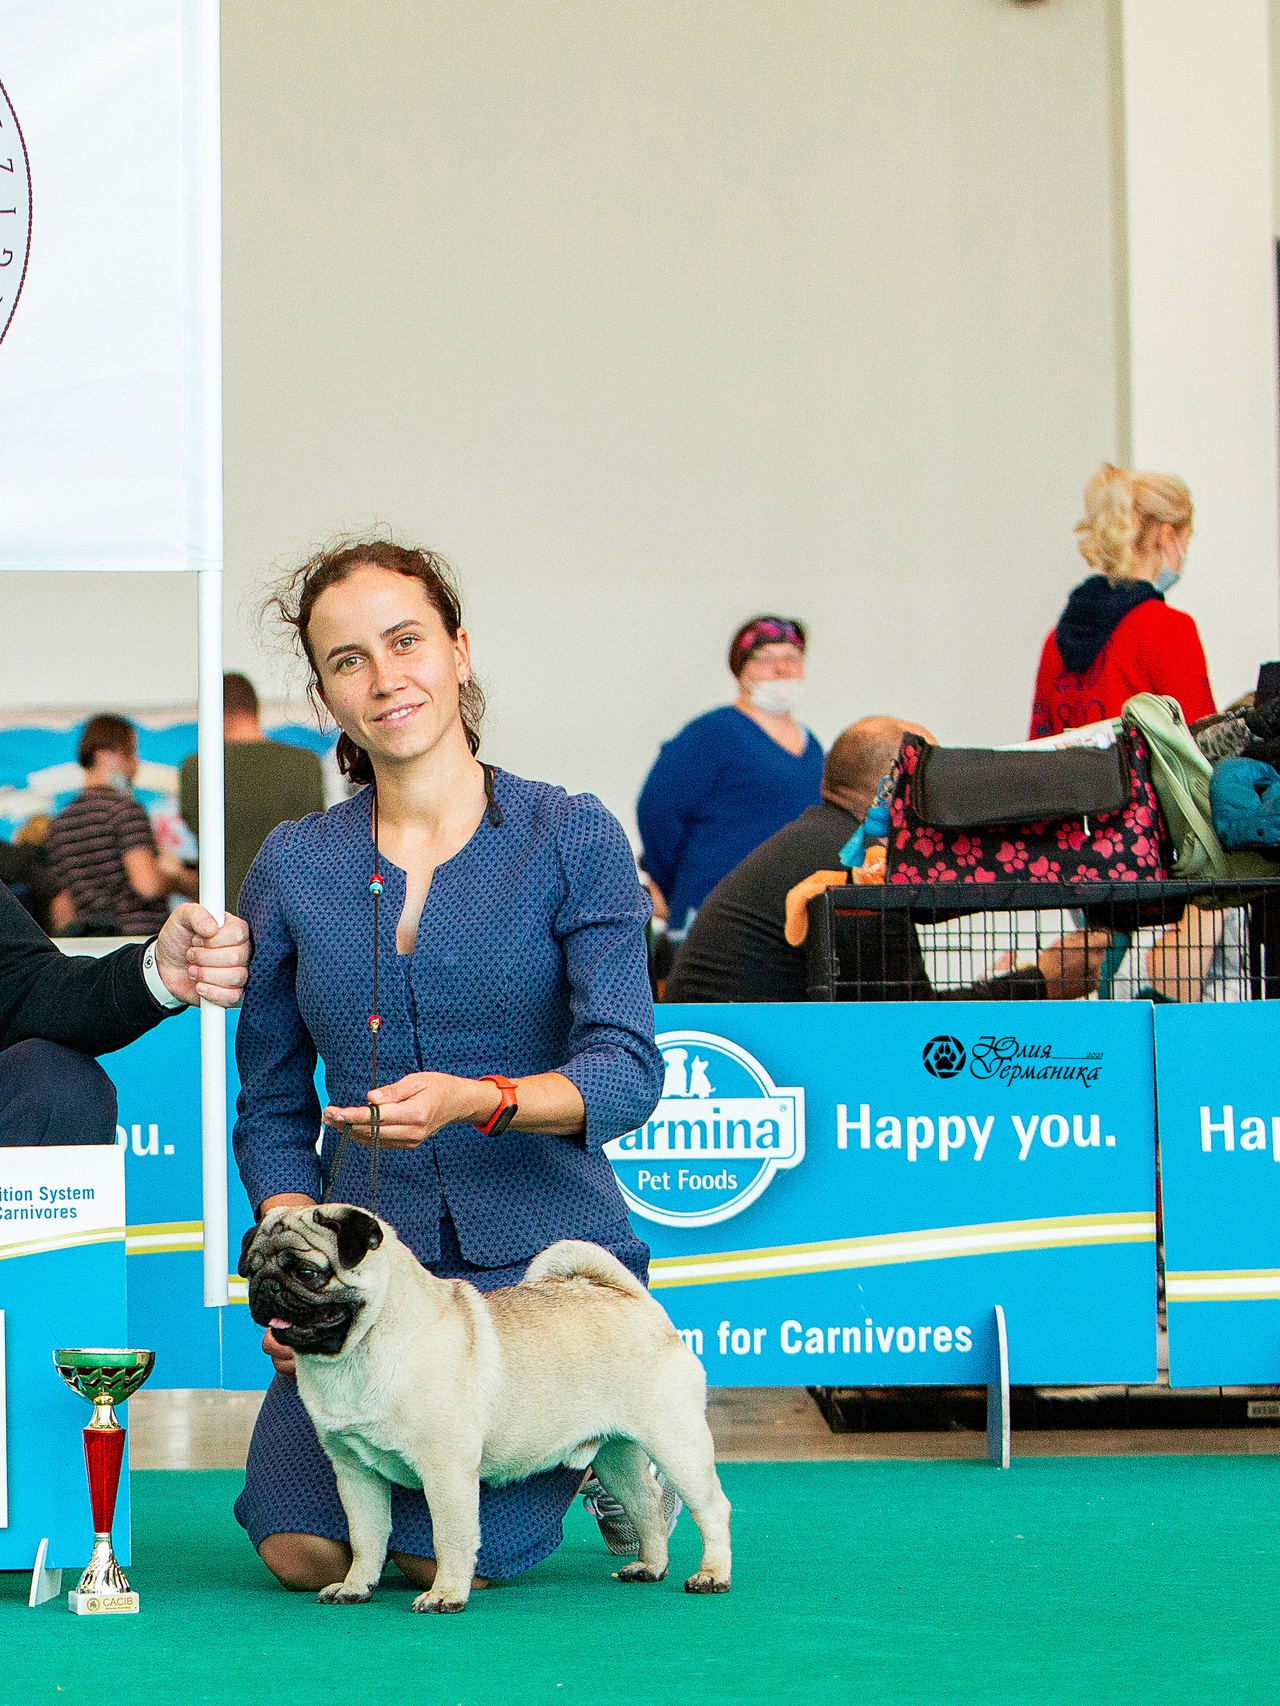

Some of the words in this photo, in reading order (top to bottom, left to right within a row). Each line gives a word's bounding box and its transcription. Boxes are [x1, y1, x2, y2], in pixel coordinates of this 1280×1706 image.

[619, 1106, 780, 1151] armina
[836, 1103, 995, 1162] Happy
[1011, 1113, 1117, 1161] you.
[38, 1185, 95, 1202] System
[638, 1169, 671, 1191] Pet
[678, 1169, 738, 1190] Foods
[717, 1320, 767, 1355] for
[780, 1317, 973, 1354] Carnivores
[102, 1596, 134, 1607] CACIB
